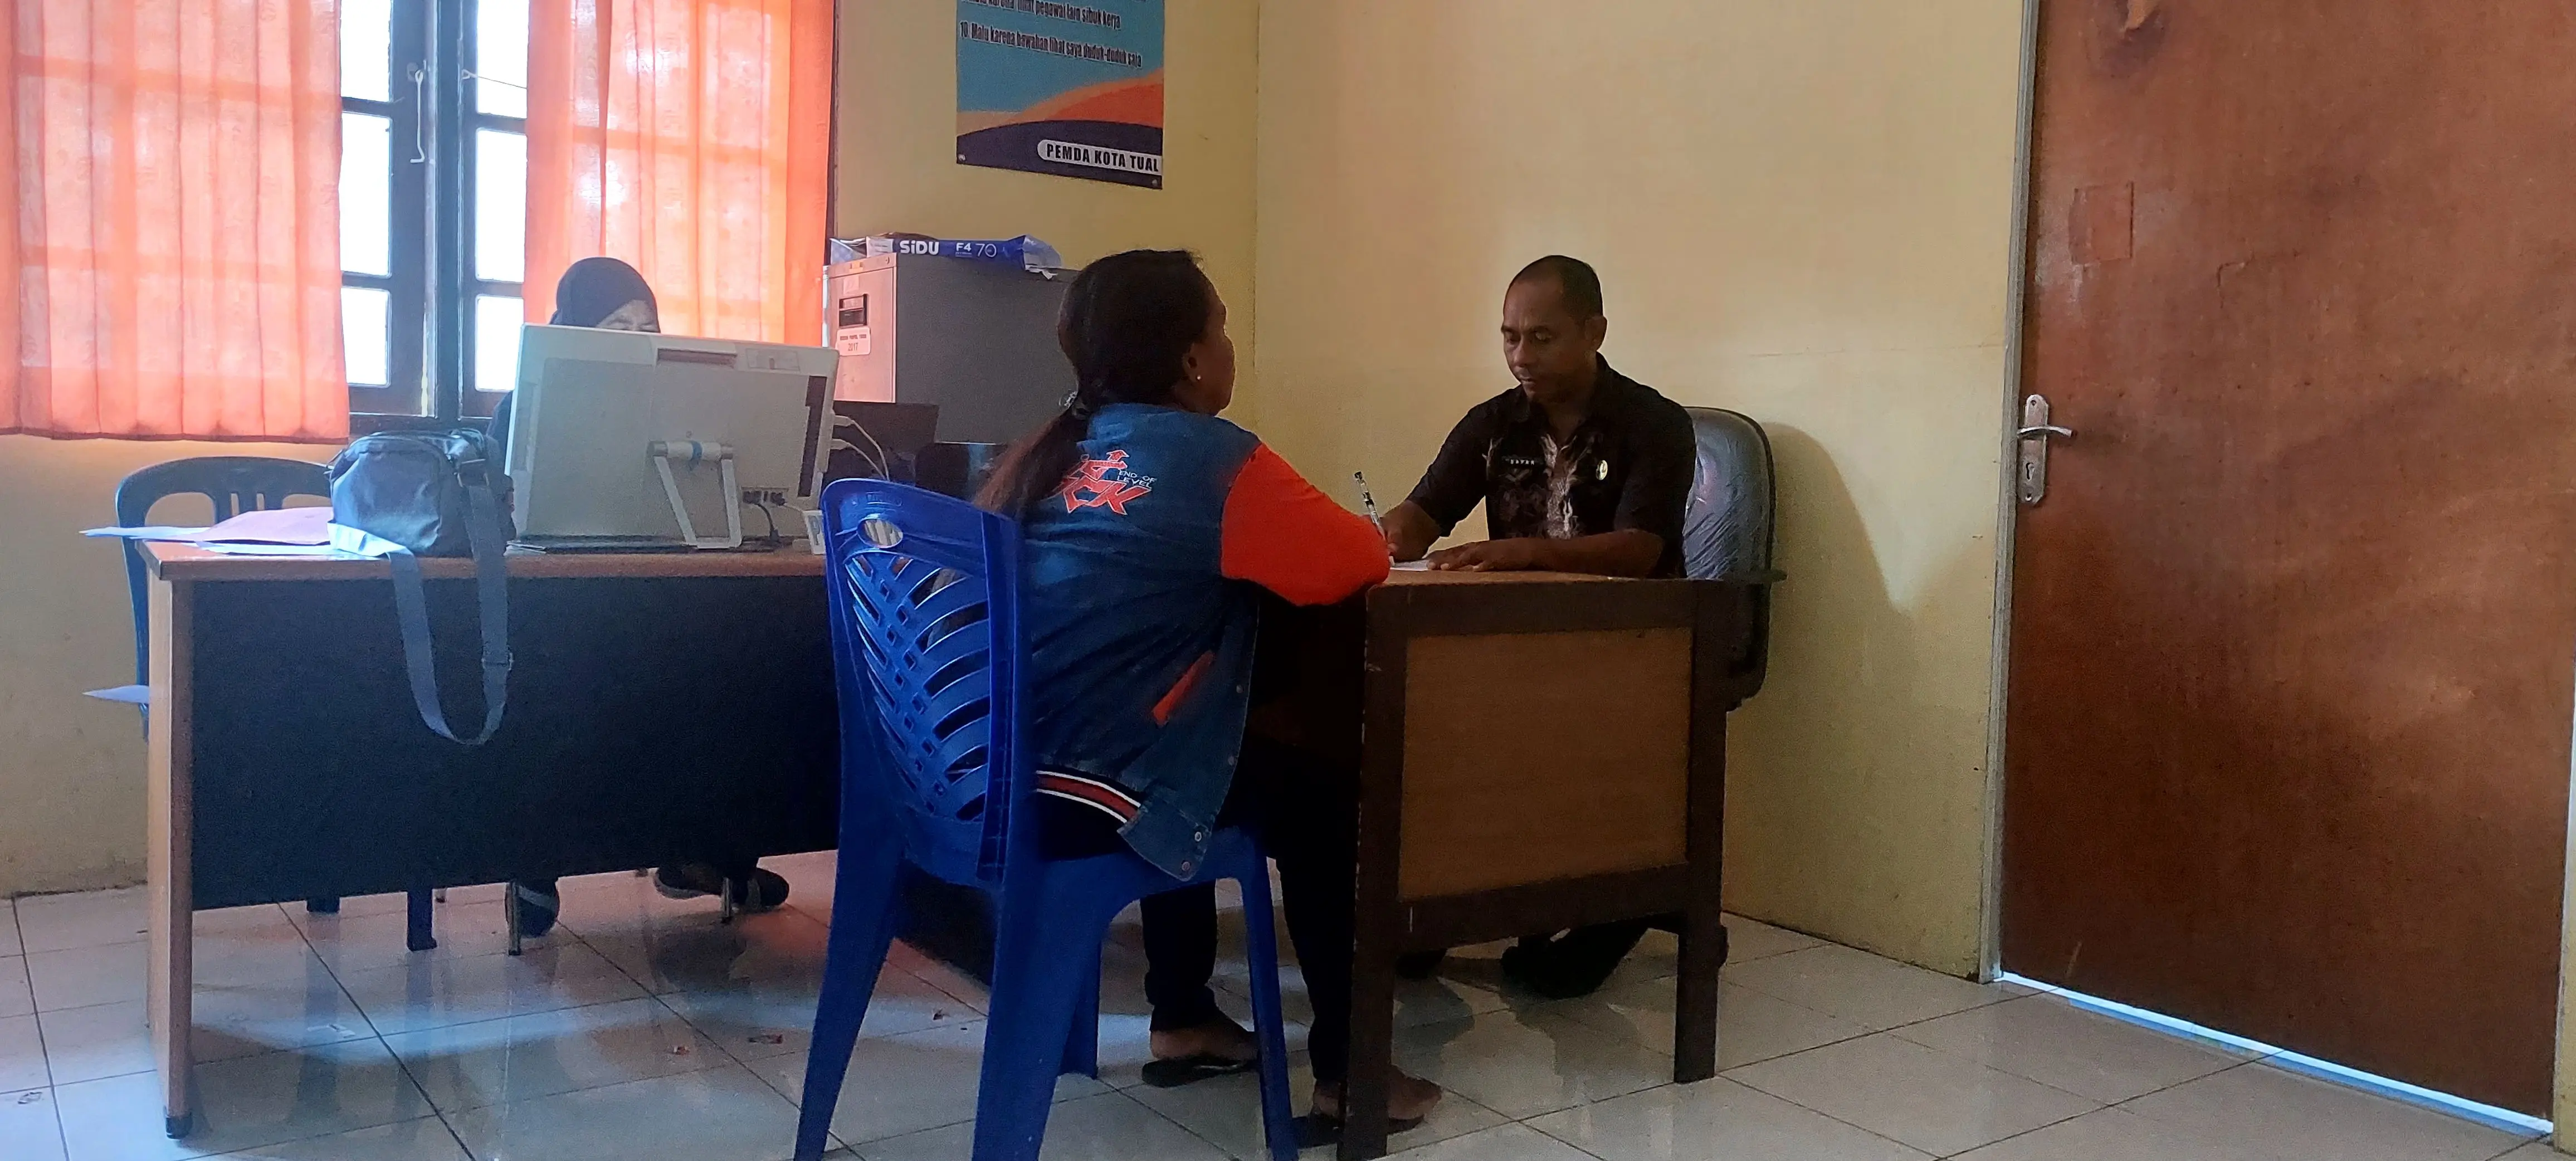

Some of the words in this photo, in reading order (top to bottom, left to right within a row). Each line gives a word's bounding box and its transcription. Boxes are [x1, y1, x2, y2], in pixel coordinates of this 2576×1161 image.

[1036, 1, 1066, 18] pegawai
[1067, 4, 1081, 21] lain
[1082, 7, 1102, 25] sibuk
[1103, 11, 1121, 30] kerja
[972, 22, 989, 41] Malu
[990, 26, 1016, 46] karena
[1017, 31, 1048, 51] bawahan
[1050, 36, 1065, 54] lihat
[1066, 42, 1082, 57] saya
[1128, 52, 1142, 67] saja
[1046, 143, 1090, 163] PEMDA
[1094, 150, 1126, 168] KOTA
[1129, 155, 1159, 172] TUAL
[956, 242, 972, 252] F4
[975, 243, 997, 257] 70
[1116, 475, 1153, 489] LEVEL
[1118, 470, 1138, 478] END
